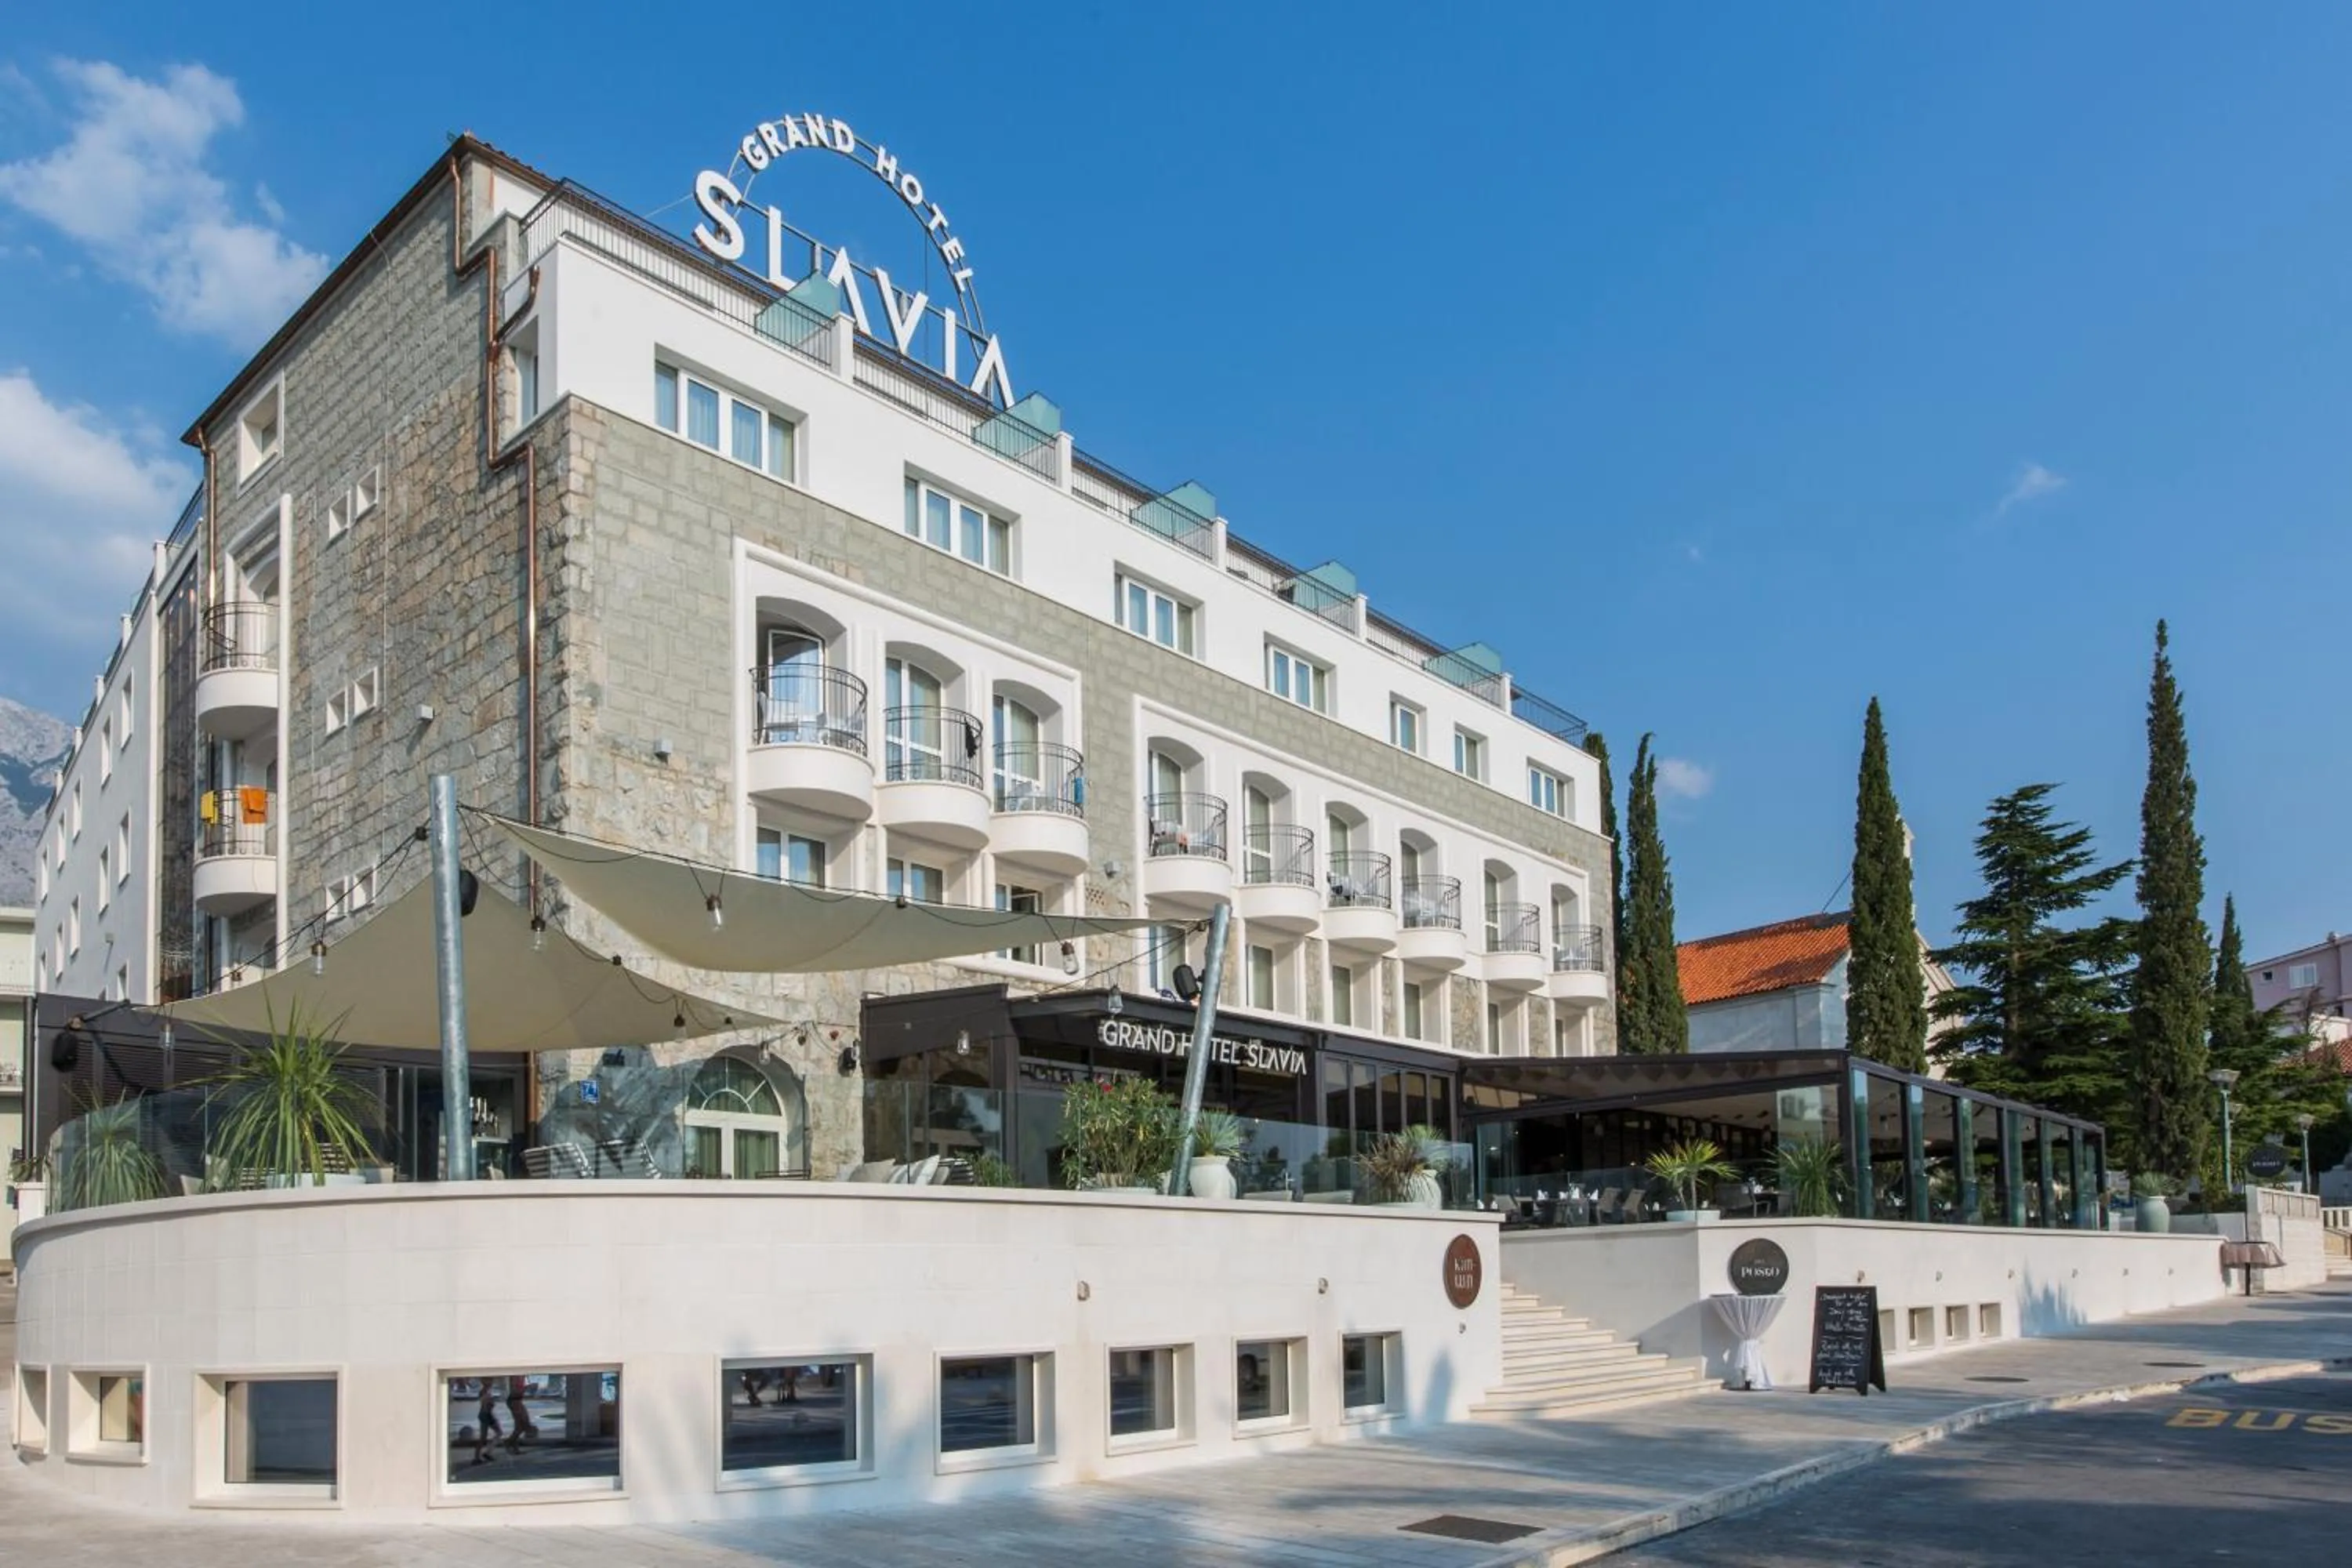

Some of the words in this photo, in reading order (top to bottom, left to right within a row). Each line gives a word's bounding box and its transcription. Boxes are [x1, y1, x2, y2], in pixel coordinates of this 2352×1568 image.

[742, 113, 855, 170] GRAND
[876, 145, 974, 292] HOTEL
[692, 169, 1015, 408] SLAVIA
[1102, 1020, 1176, 1054] GRAND
[1181, 1033, 1240, 1065] HTEL
[1247, 1044, 1308, 1076] SLAVIA
[2165, 1409, 2352, 1435] BUS
